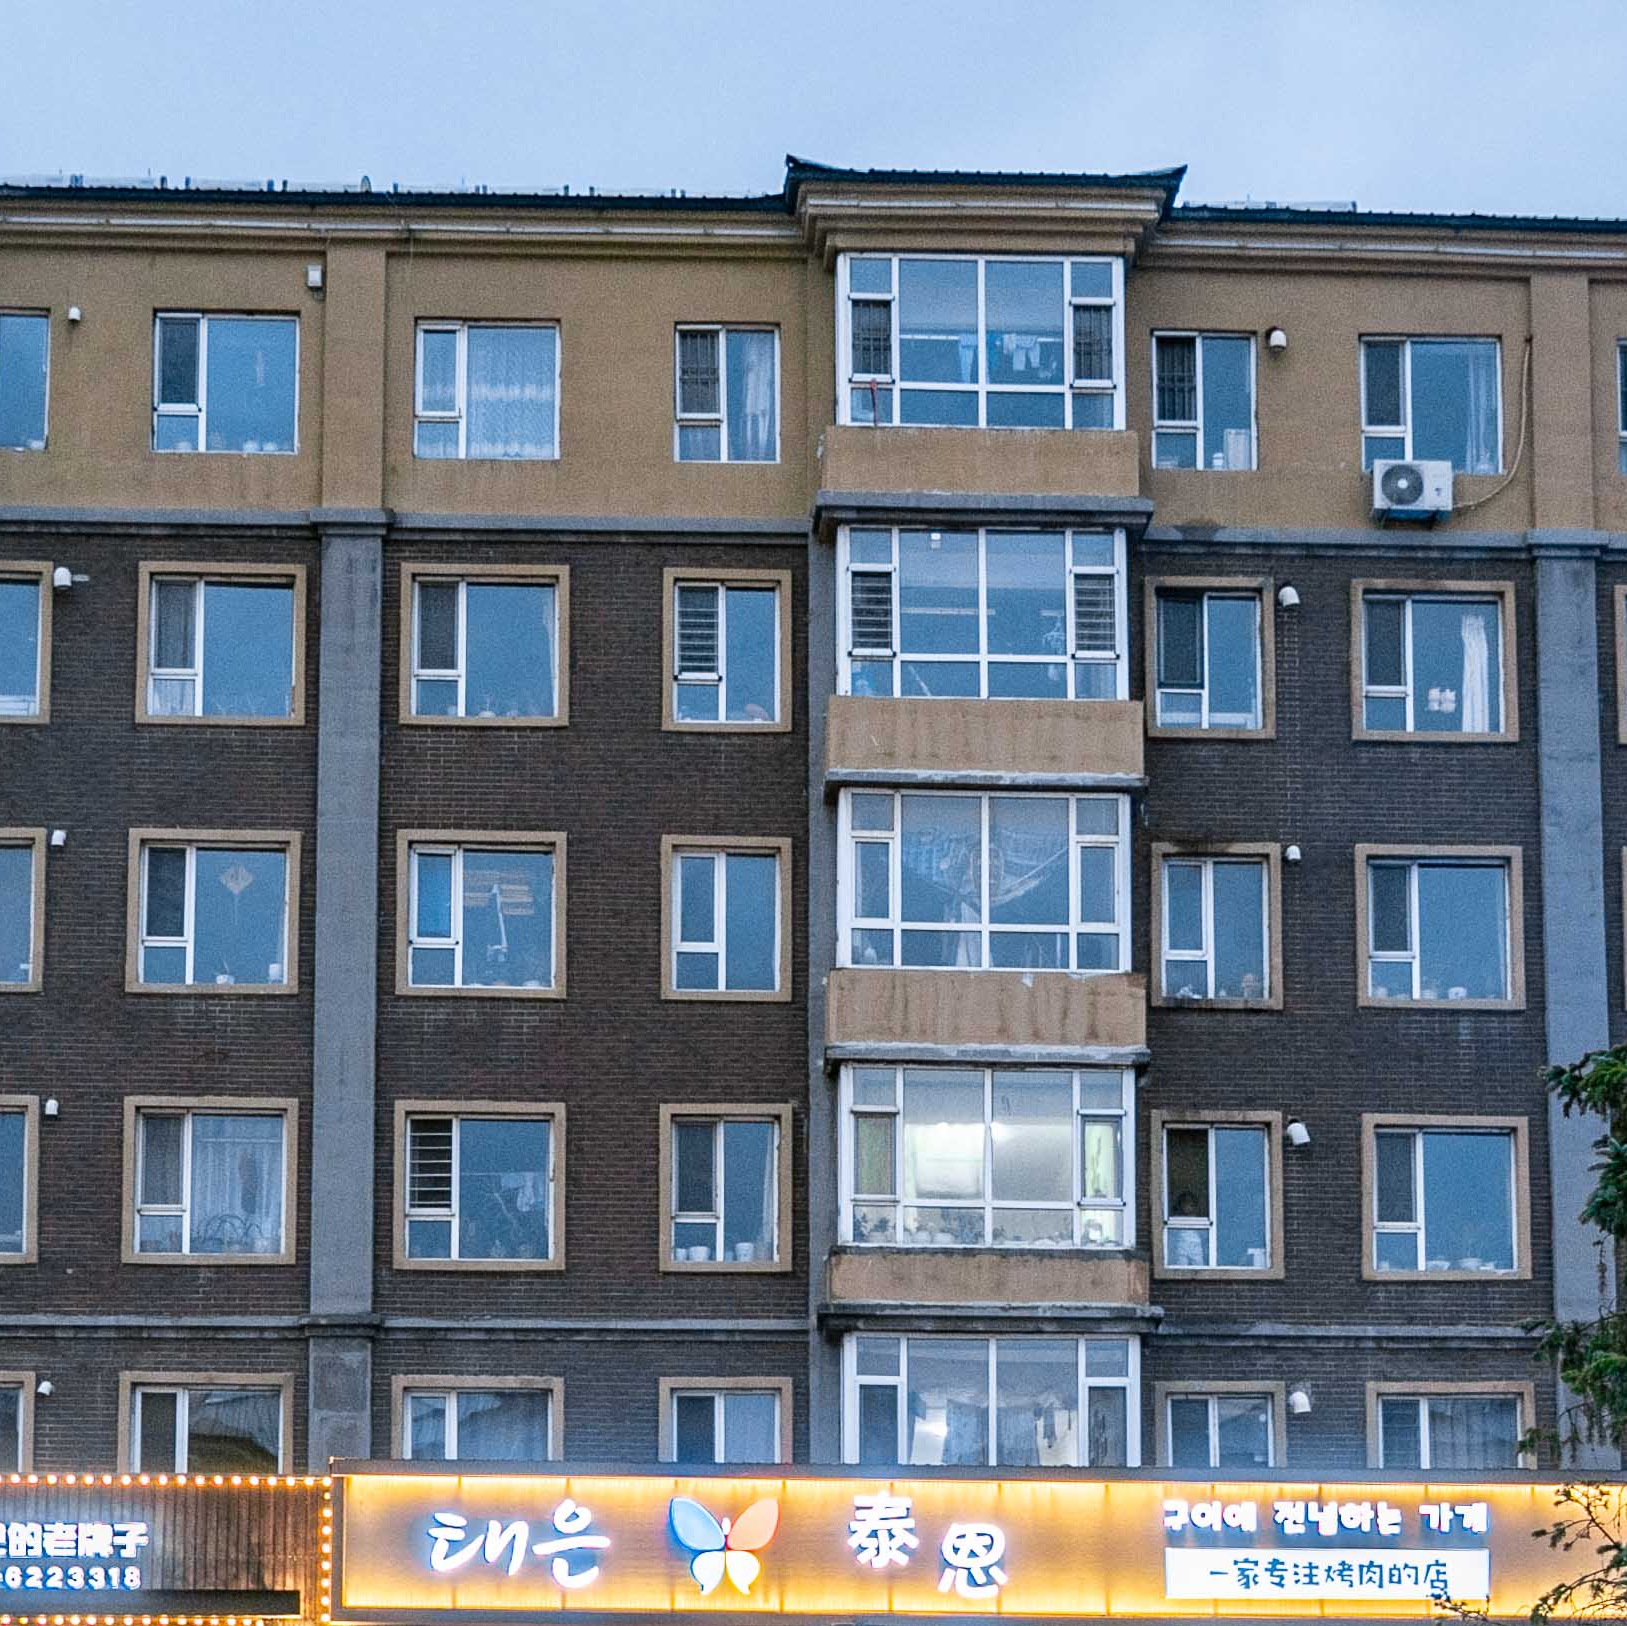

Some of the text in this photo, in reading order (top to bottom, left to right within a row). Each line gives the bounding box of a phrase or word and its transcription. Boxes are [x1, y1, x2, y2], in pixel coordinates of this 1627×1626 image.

[427, 1498, 612, 1589] 태은
[847, 1493, 1007, 1599] 泰恩
[1209, 1557, 1450, 1590] 一家专注烤肉的店
